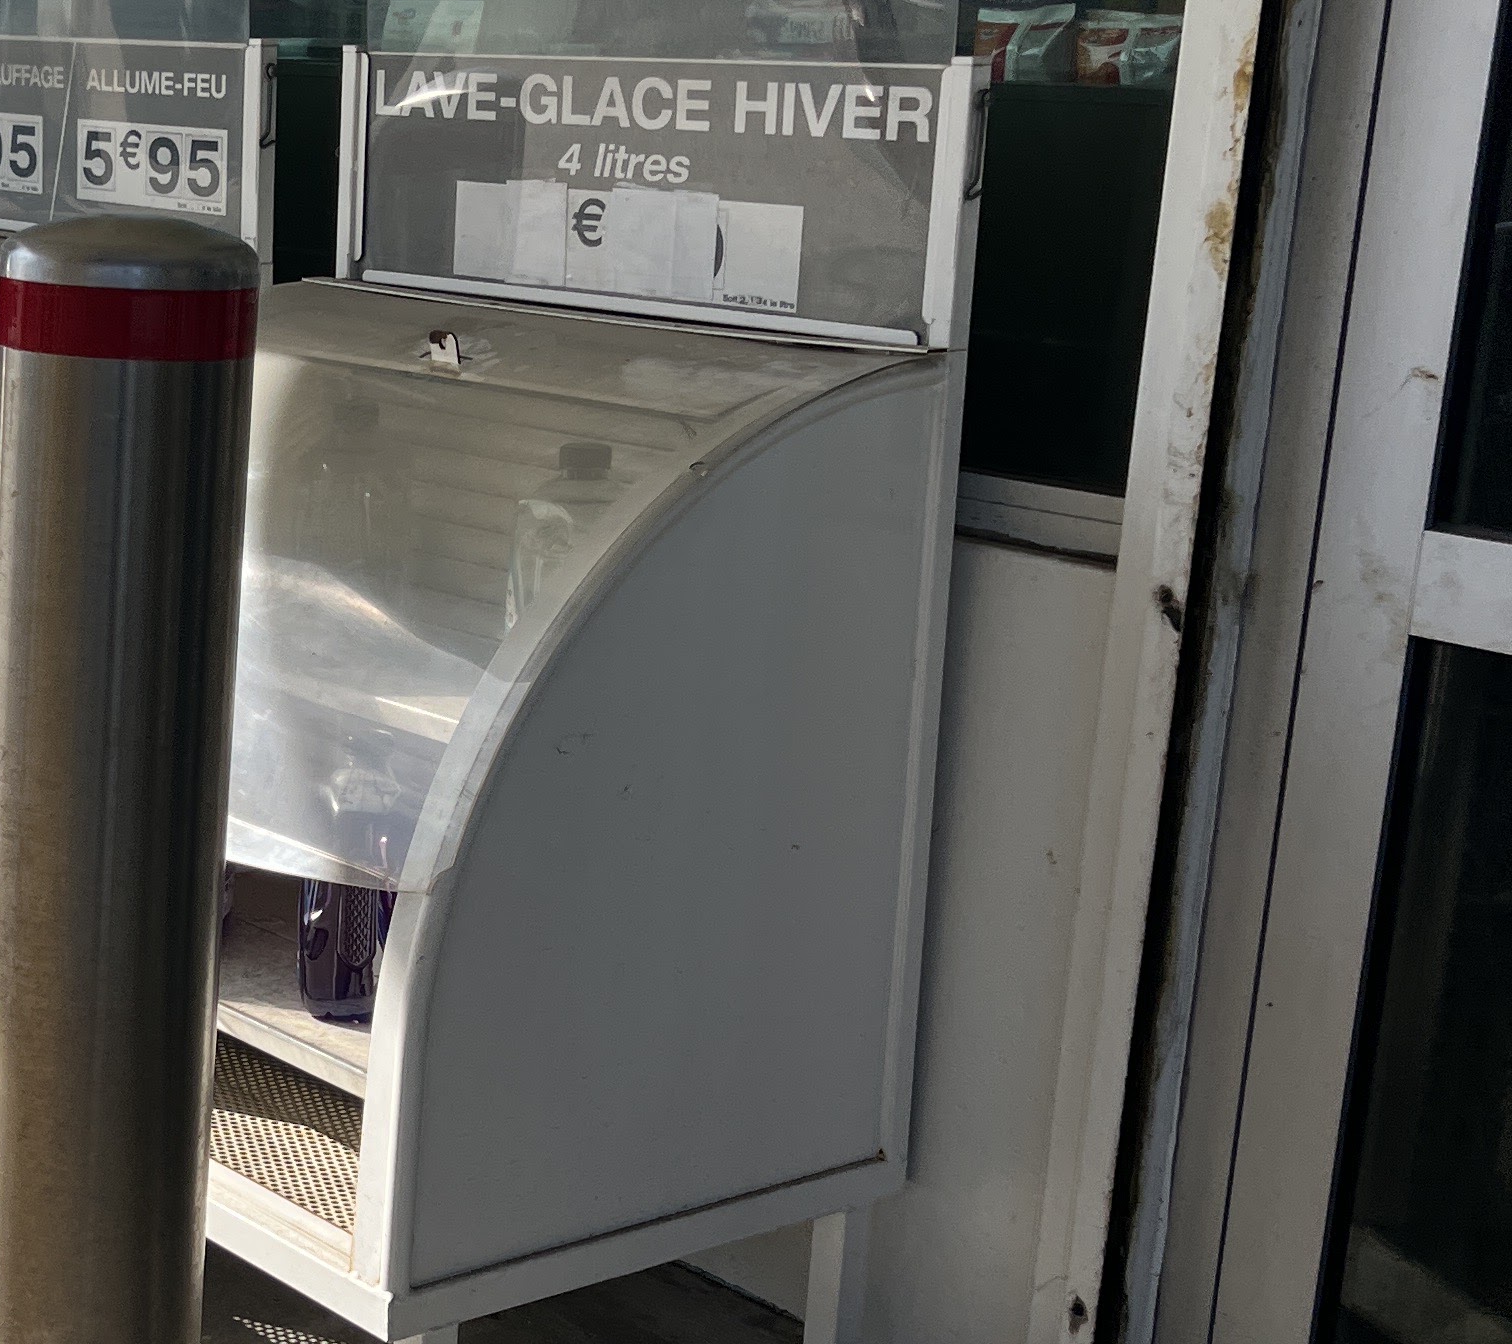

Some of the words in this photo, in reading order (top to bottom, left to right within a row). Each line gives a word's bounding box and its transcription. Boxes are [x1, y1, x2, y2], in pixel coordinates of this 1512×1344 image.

[86, 68, 227, 99] ALLUME-FEU
[375, 69, 712, 132] LAVE-GLACE
[734, 80, 933, 144] HIVER
[557, 143, 583, 176] 4
[593, 143, 691, 184] litres
[571, 197, 607, 248] €
